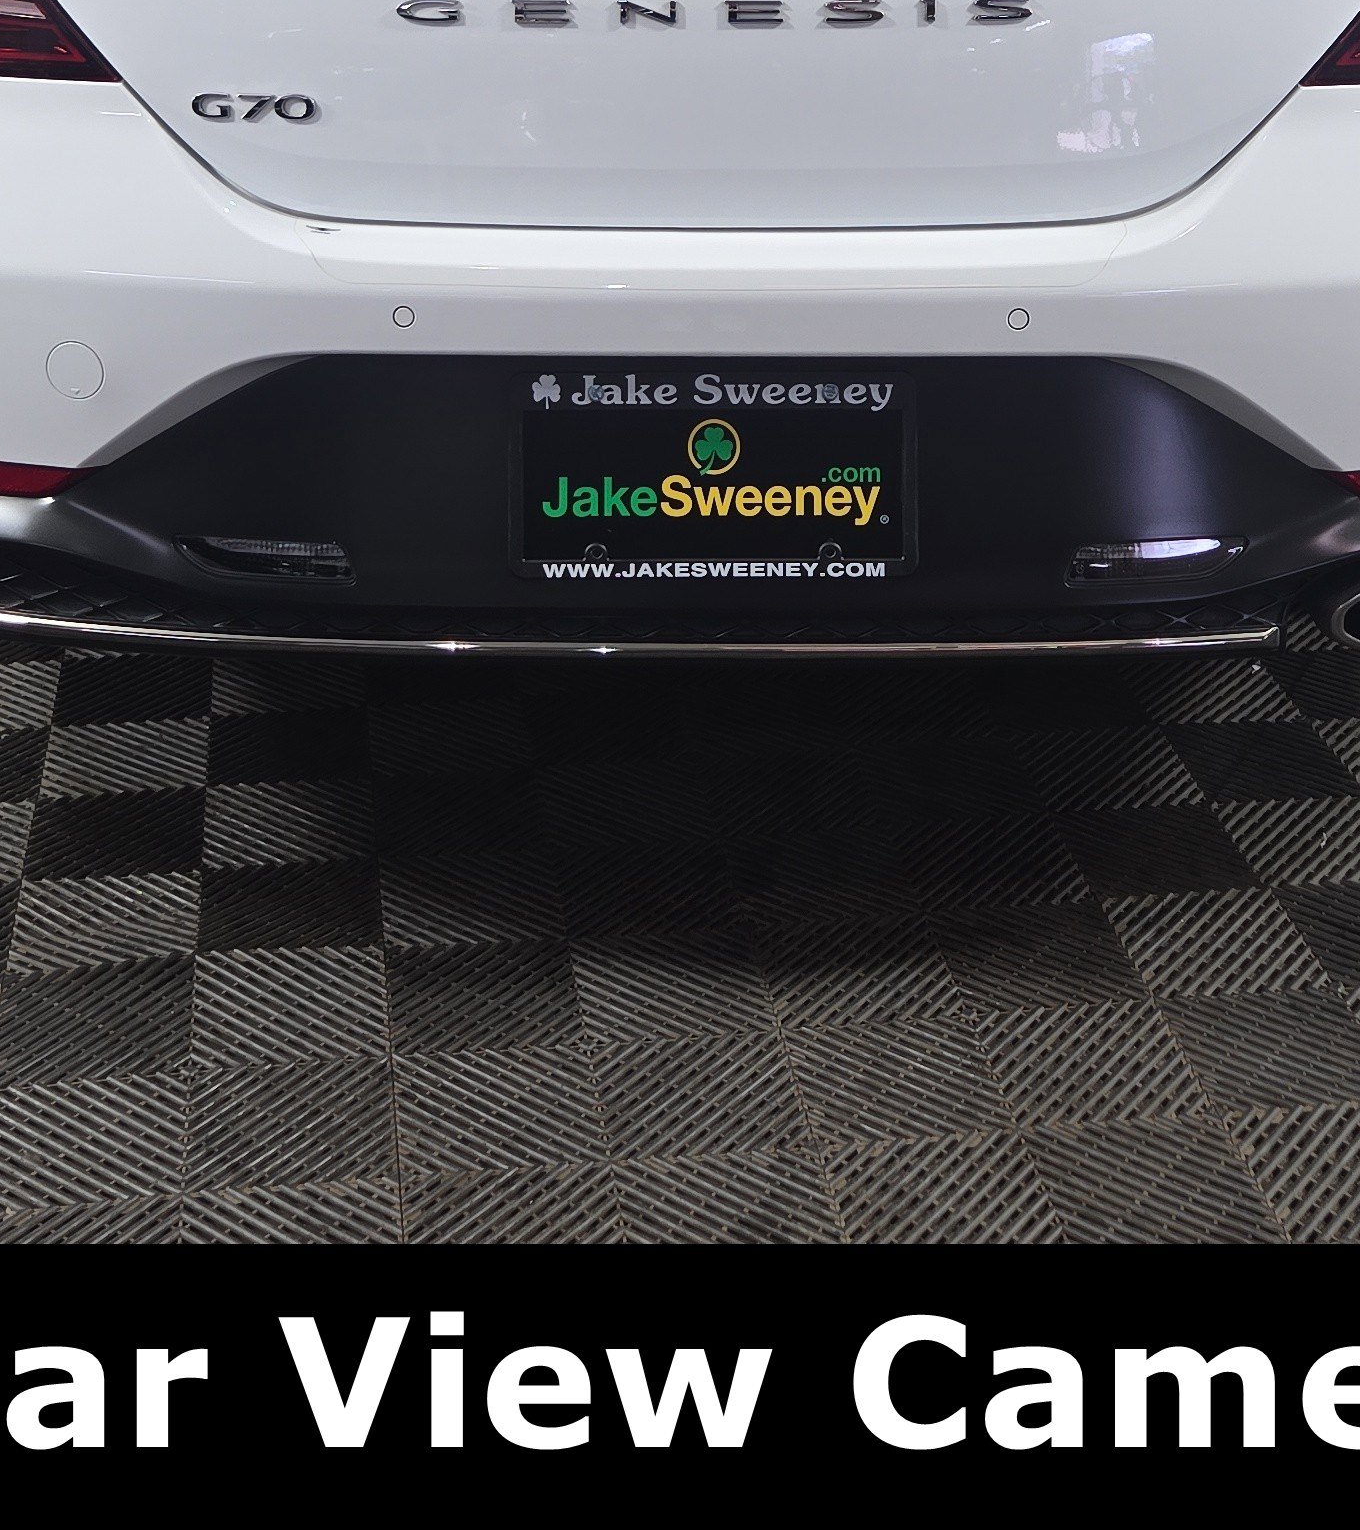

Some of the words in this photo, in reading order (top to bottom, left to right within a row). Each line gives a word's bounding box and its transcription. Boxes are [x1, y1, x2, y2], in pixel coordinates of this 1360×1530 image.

[191, 93, 319, 124] G70
[571, 374, 678, 405] Jake
[693, 373, 894, 412] Sweeney
[542, 562, 886, 578] WWW.JAKESWEENEY.COM
